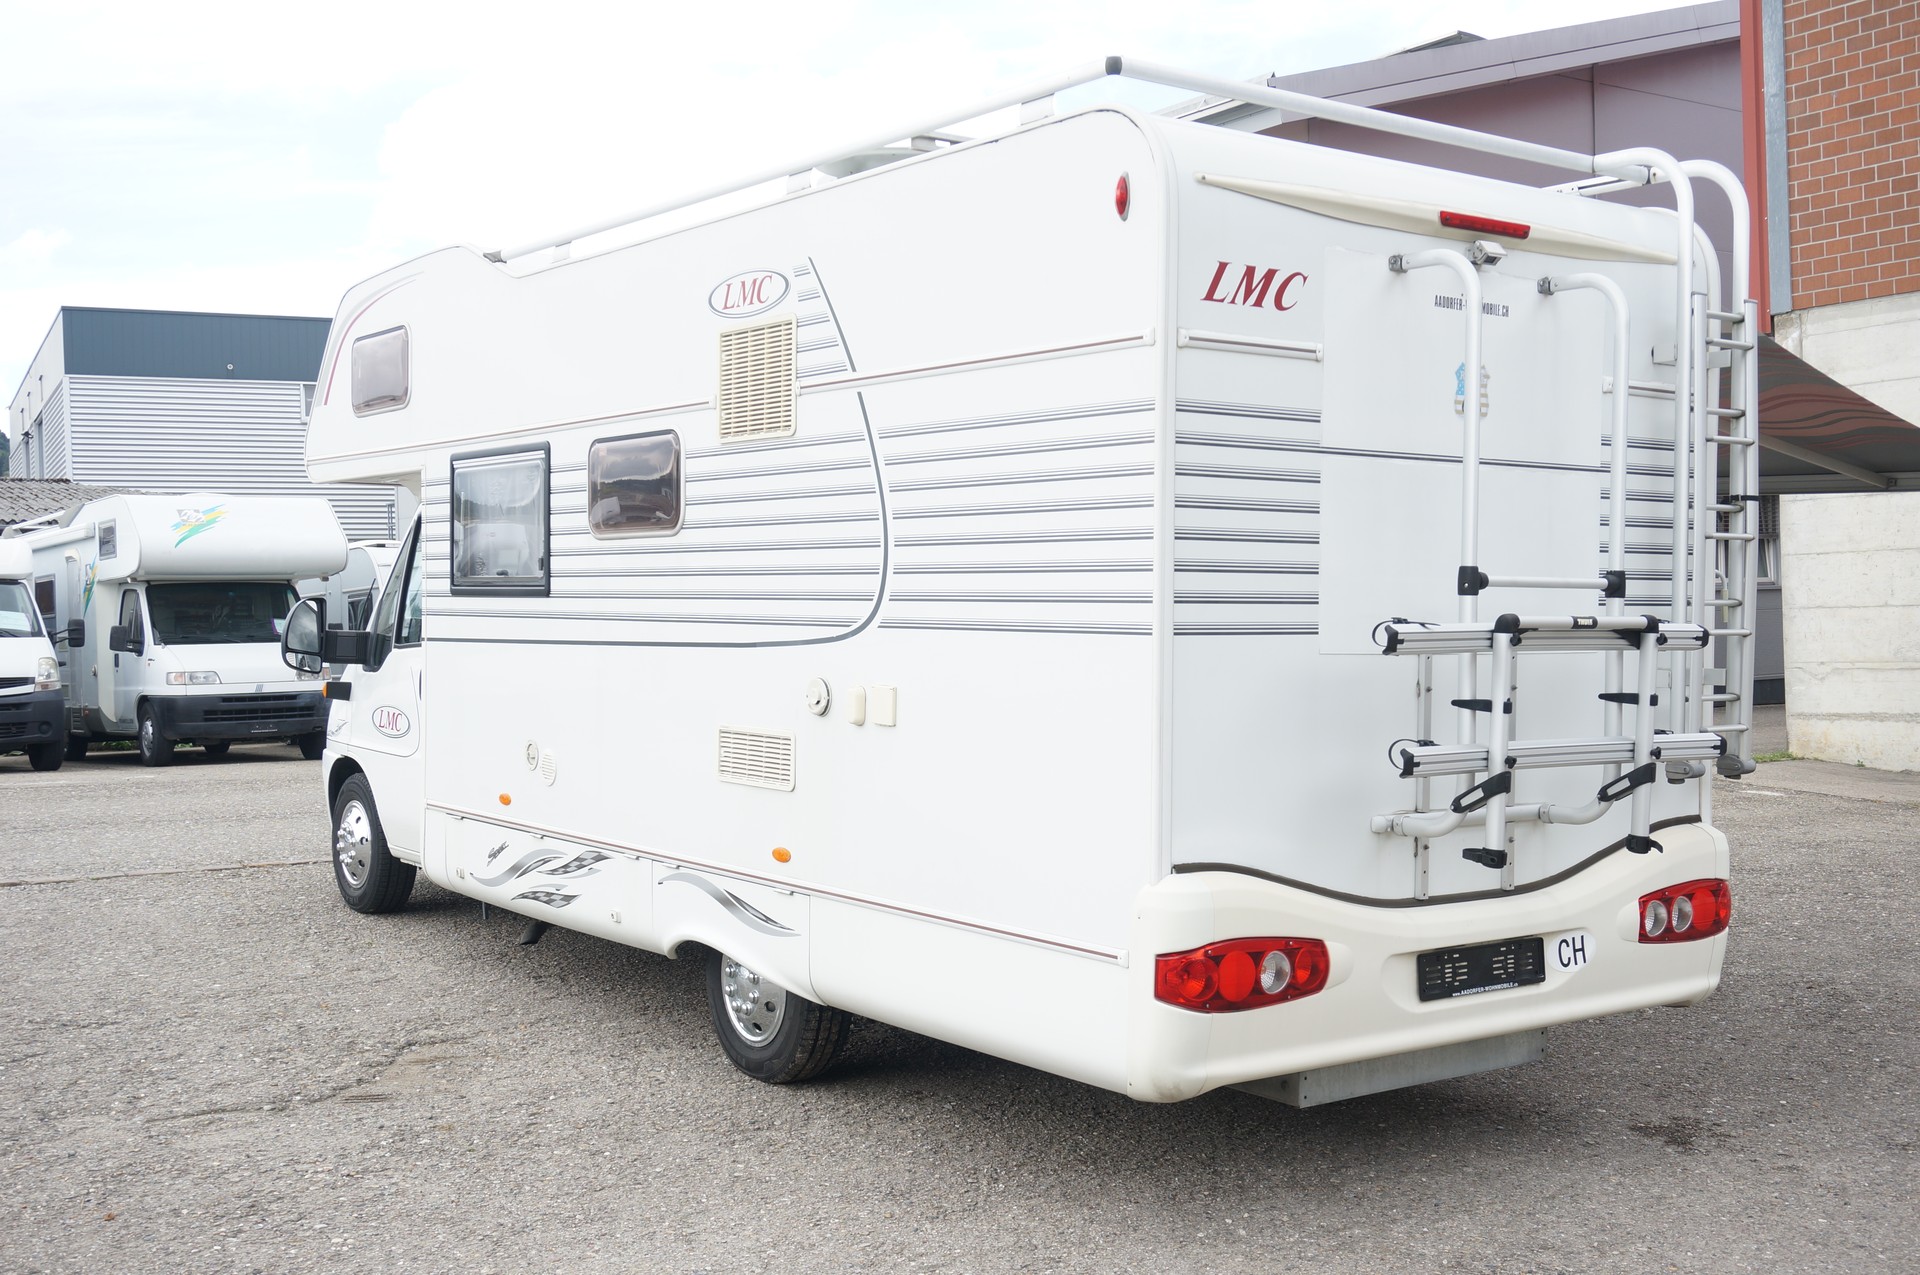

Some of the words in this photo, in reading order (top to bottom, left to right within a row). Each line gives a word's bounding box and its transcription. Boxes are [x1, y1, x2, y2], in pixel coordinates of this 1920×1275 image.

[722, 273, 773, 310] LMC
[1200, 260, 1309, 311] LMC
[379, 709, 402, 732] LMC
[1558, 934, 1587, 968] CH
